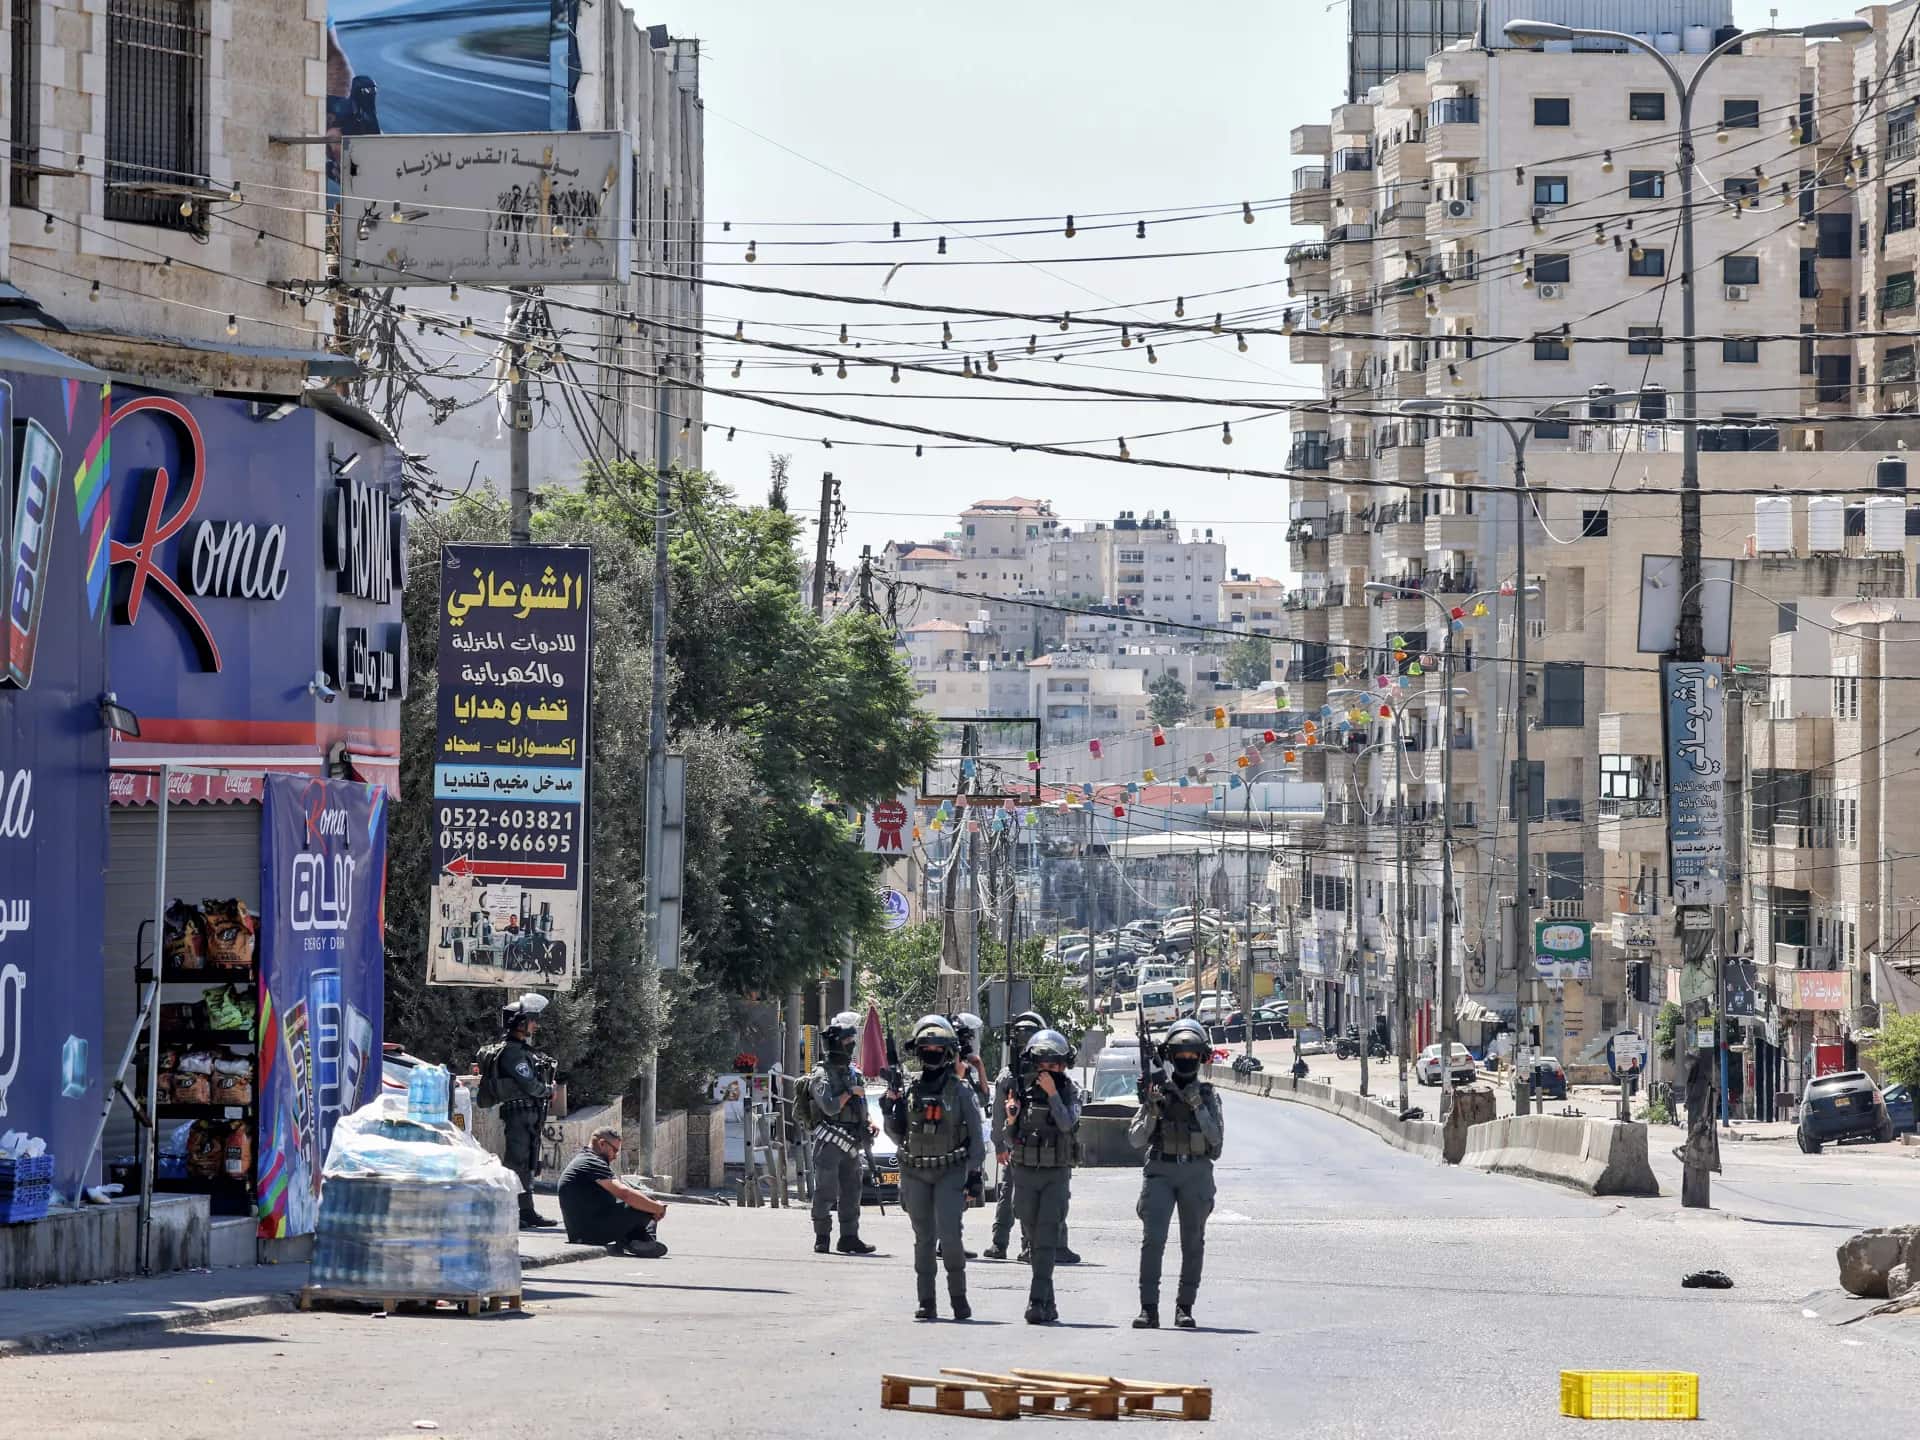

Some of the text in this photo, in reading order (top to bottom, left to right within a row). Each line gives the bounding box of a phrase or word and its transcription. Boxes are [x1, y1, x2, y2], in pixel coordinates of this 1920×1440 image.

[395, 150, 452, 178] للأزياء
[455, 147, 508, 170] القدس
[110, 395, 289, 673] Roma
[350, 478, 393, 605] ROMA
[10, 462, 48, 637] BLU
[447, 564, 583, 627] الشوعاني
[452, 631, 577, 655] للأدوات المنزلية
[461, 660, 564, 688] والكهربائية
[527, 696, 568, 721] تحف
[1672, 666, 1721, 776] الشوعاني
[444, 734, 577, 760] إكسسوارات سجاد
[443, 771, 573, 794] مدخل مخيم قلنديا
[301, 778, 346, 856] Roma
[440, 807, 572, 831] 0522-603821
[439, 830, 571, 853] 0598-966695
[290, 853, 354, 932] BLU
